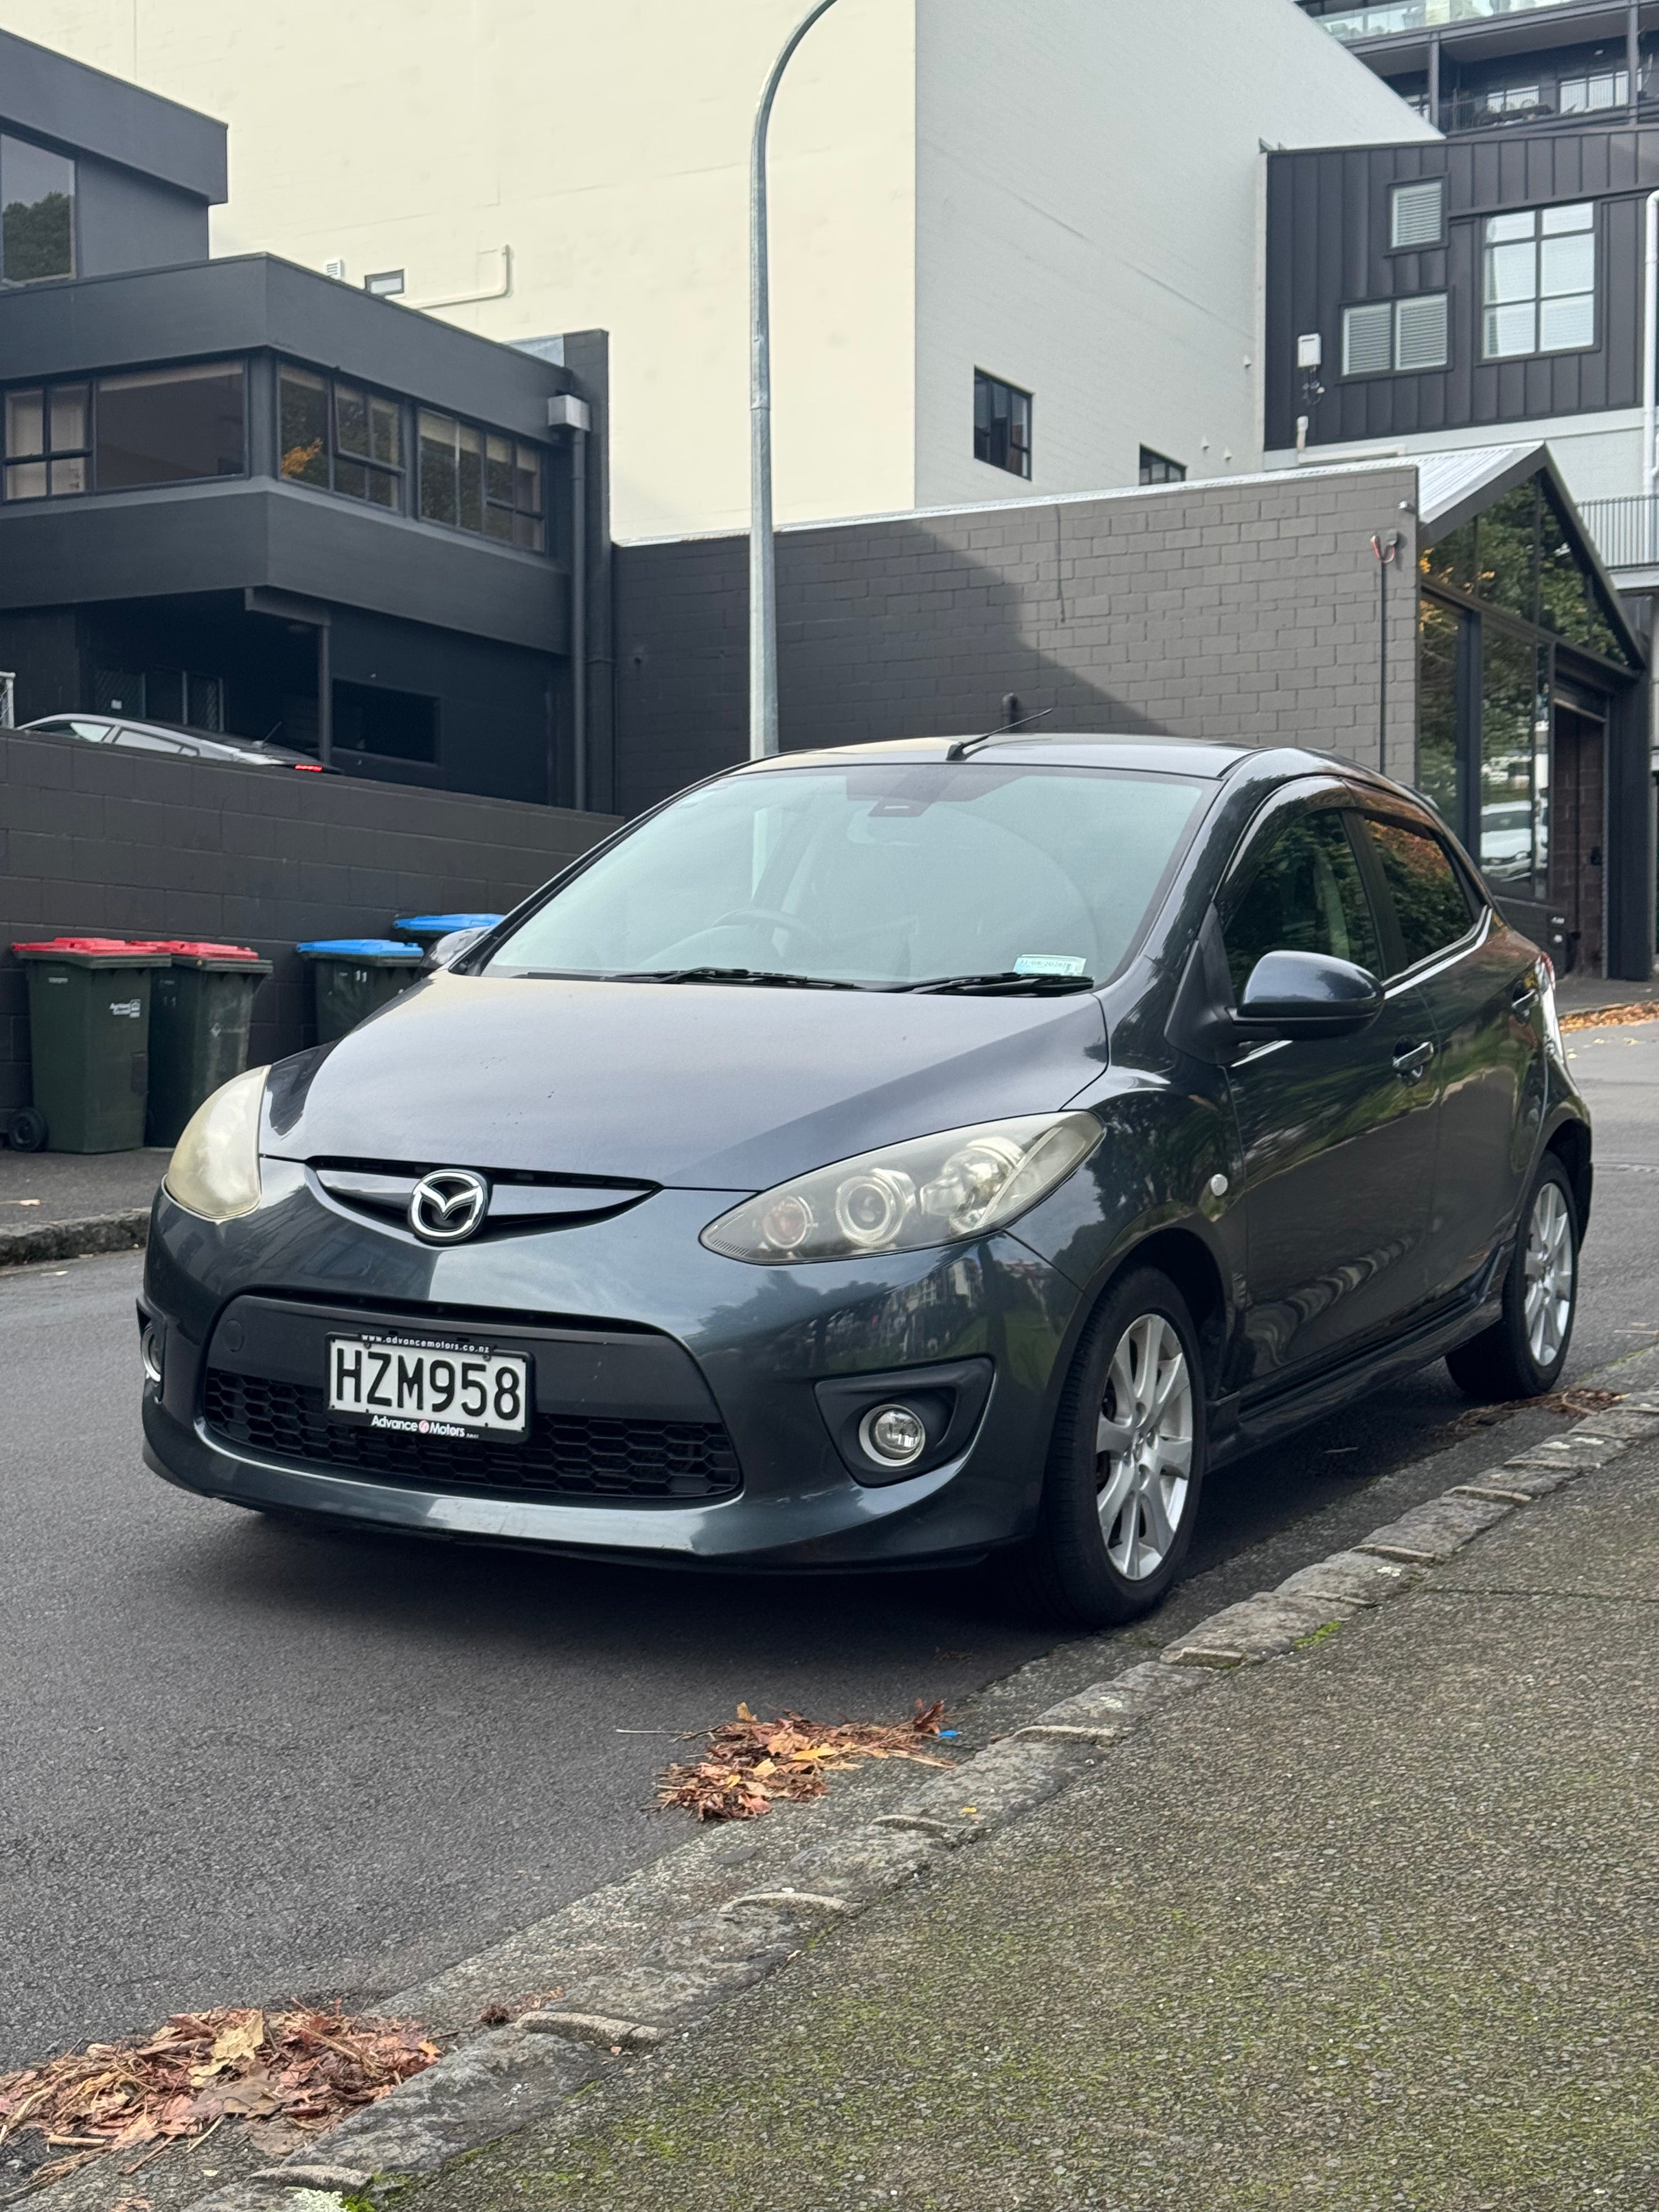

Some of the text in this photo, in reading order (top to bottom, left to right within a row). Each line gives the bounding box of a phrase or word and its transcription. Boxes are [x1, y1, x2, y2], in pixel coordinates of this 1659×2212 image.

[362, 1334, 489, 1353] www.advancemotors.co.nz
[336, 1347, 521, 1420] HZM958
[371, 1415, 465, 1437] Advance Motors
